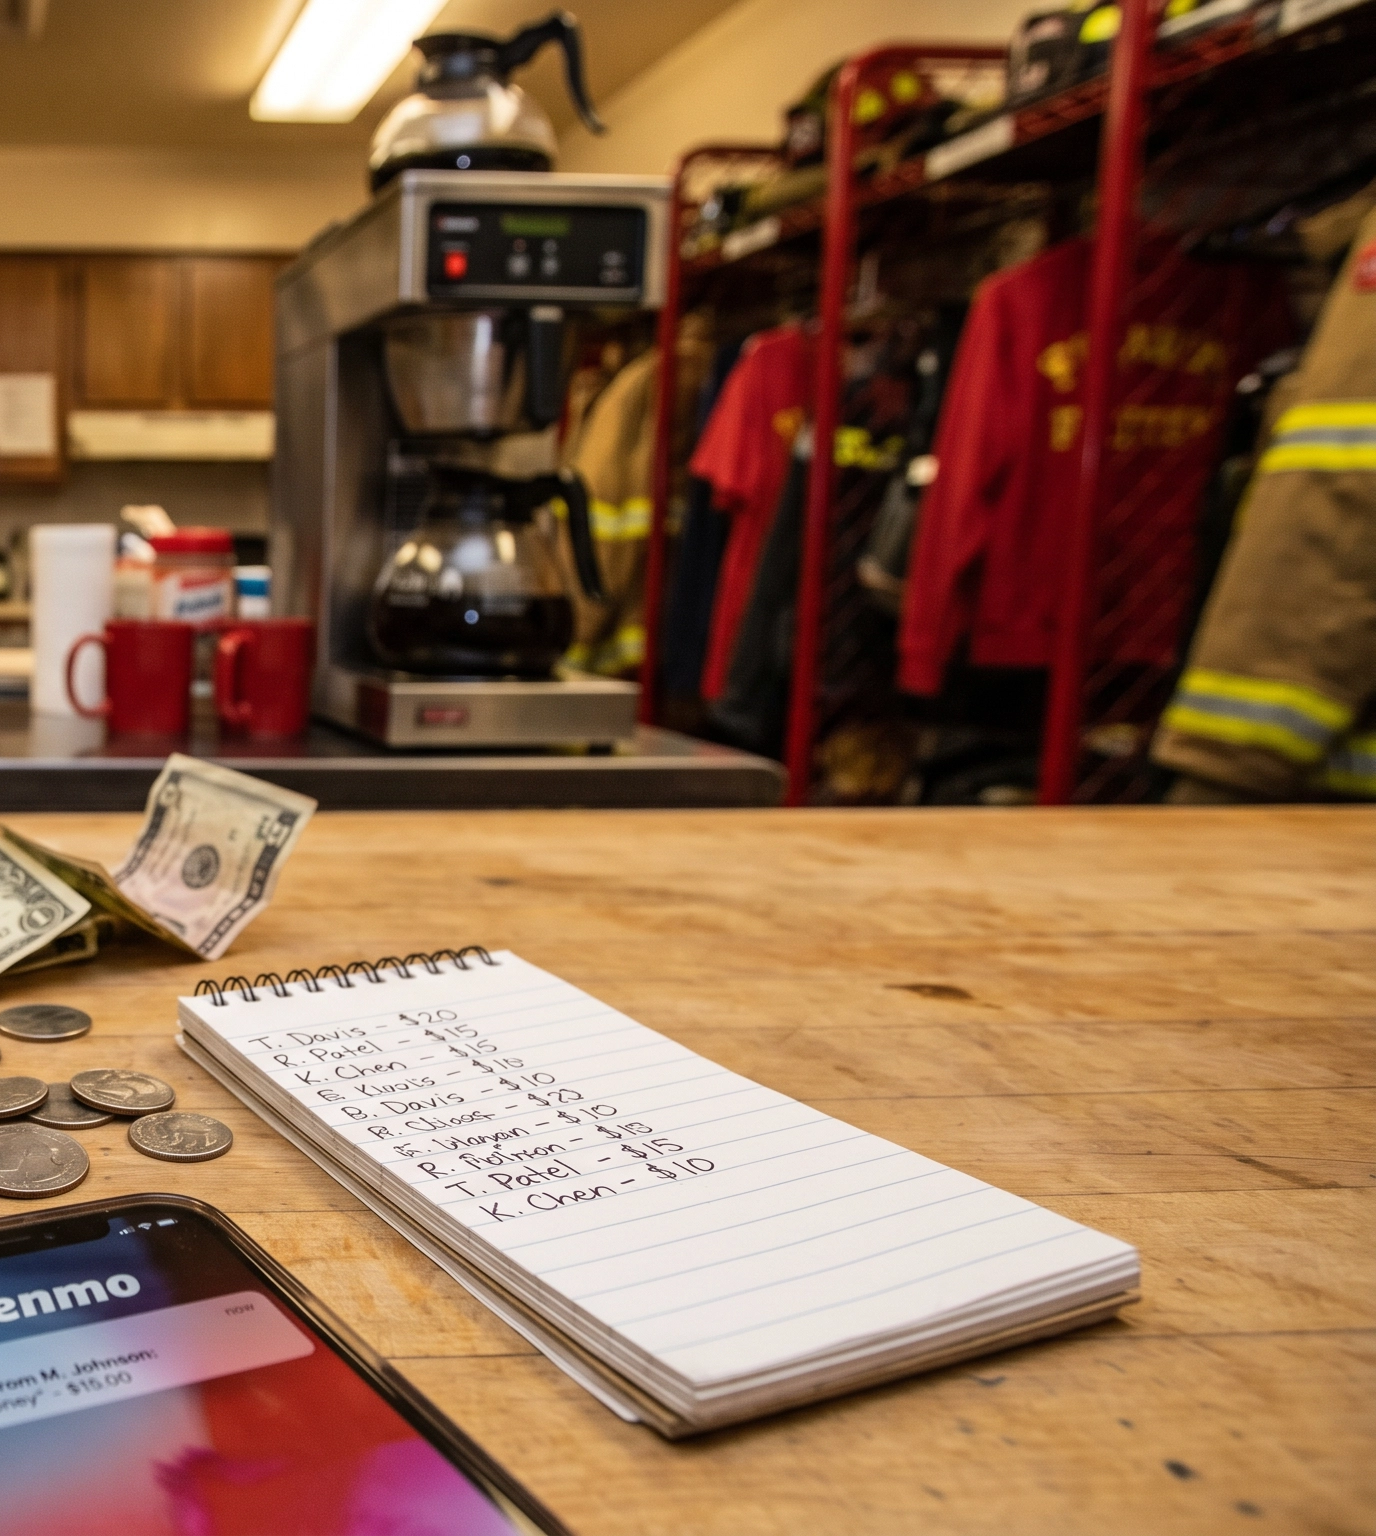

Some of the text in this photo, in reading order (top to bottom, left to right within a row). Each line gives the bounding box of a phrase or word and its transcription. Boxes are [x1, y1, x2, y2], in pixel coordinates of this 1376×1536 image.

[247, 1035, 283, 1050] T.
[286, 1026, 368, 1047] Davis
[397, 1008, 459, 1027] $20
[273, 1053, 307, 1068] R.
[308, 1039, 384, 1063] Patel
[423, 1023, 479, 1043] $15
[294, 1070, 330, 1087] K.
[334, 1060, 409, 1080] Chen
[449, 1038, 498, 1059] $15
[380, 1092, 466, 1115] Davis
[498, 1071, 557, 1092] $10
[556, 1103, 618, 1126] $10
[416, 1161, 457, 1181] R.
[443, 1180, 488, 1198] T.
[487, 1158, 583, 1190] Patel
[620, 1136, 685, 1161] $15
[478, 1201, 525, 1223] K.
[526, 1183, 619, 1212] Chen
[646, 1156, 716, 1181] $10
[224, 1303, 256, 1317] now
[39, 1366, 67, 1383] M.
[71, 1348, 159, 1377] Johnson:
[65, 1369, 133, 1397] $15.00
